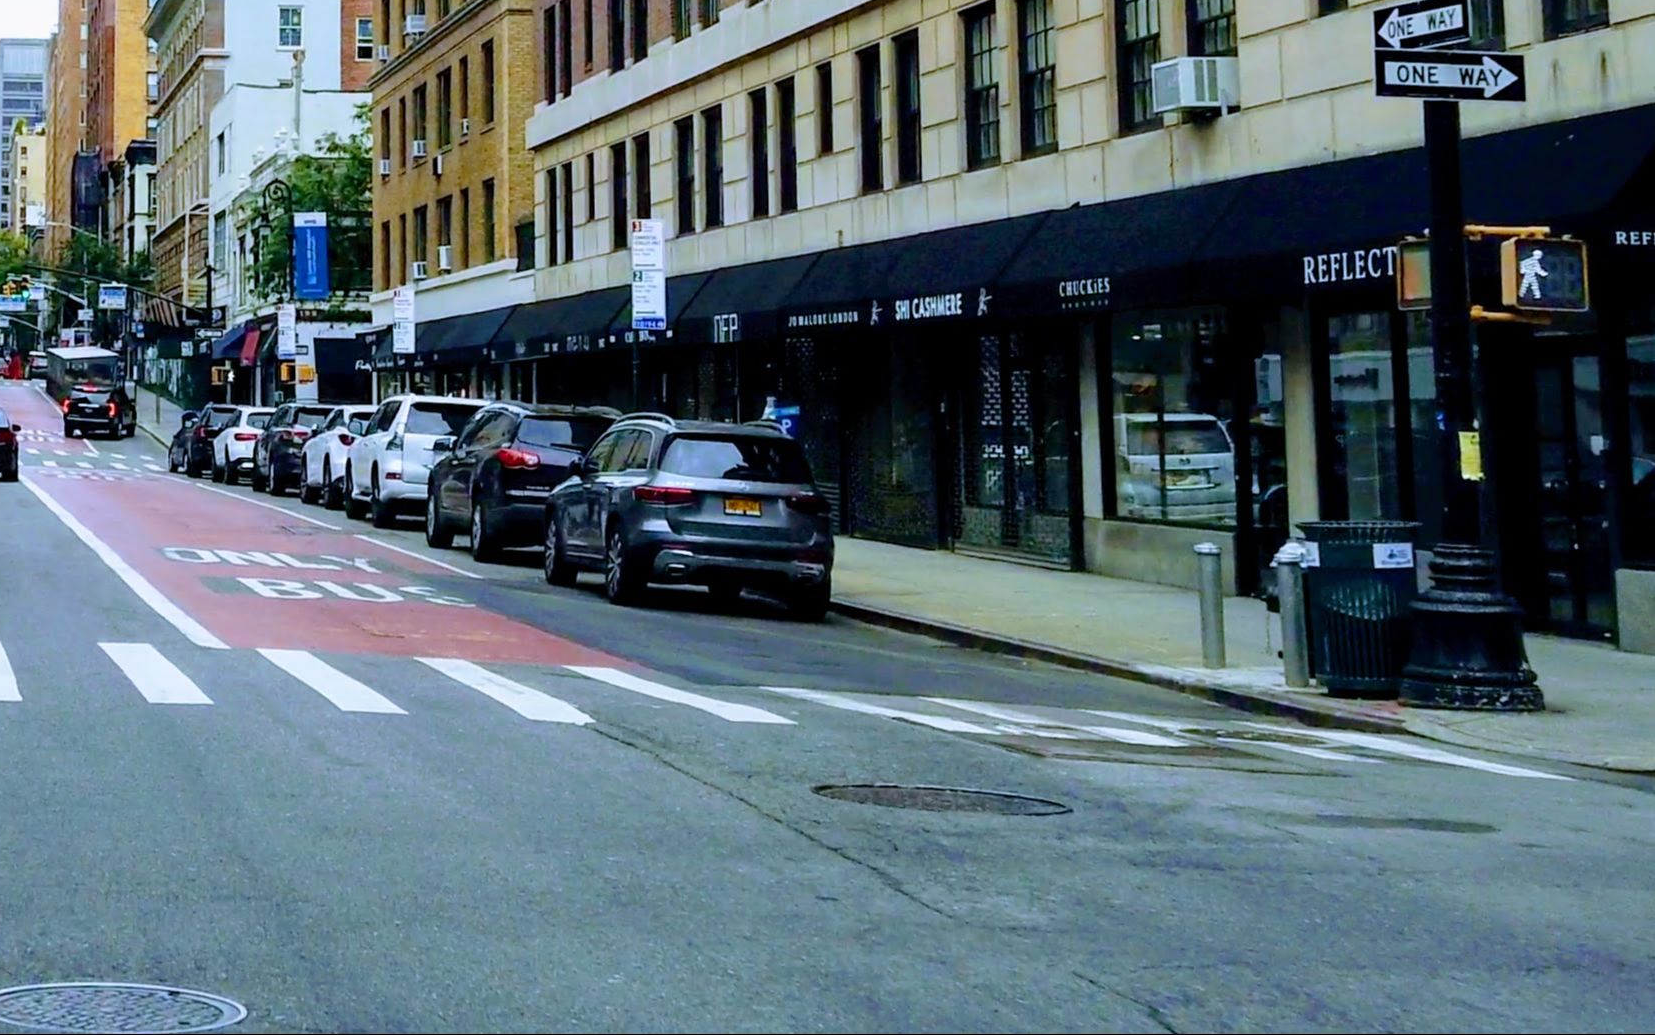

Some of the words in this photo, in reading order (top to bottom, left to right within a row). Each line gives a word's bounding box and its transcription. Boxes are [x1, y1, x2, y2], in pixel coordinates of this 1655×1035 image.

[1387, 17, 1414, 39] ONE
[1426, 8, 1457, 31] WAY
[1397, 65, 1439, 84] ONE
[1459, 67, 1502, 86] WAY
[1615, 231, 1655, 246] REF
[788, 316, 797, 327] JO
[798, 313, 828, 326] MALONE
[829, 311, 858, 324] LONDON
[895, 299, 910, 321] SHI
[912, 293, 963, 319] CASHMERE
[163, 547, 382, 574] ONLY
[236, 576, 477, 608] BUS
